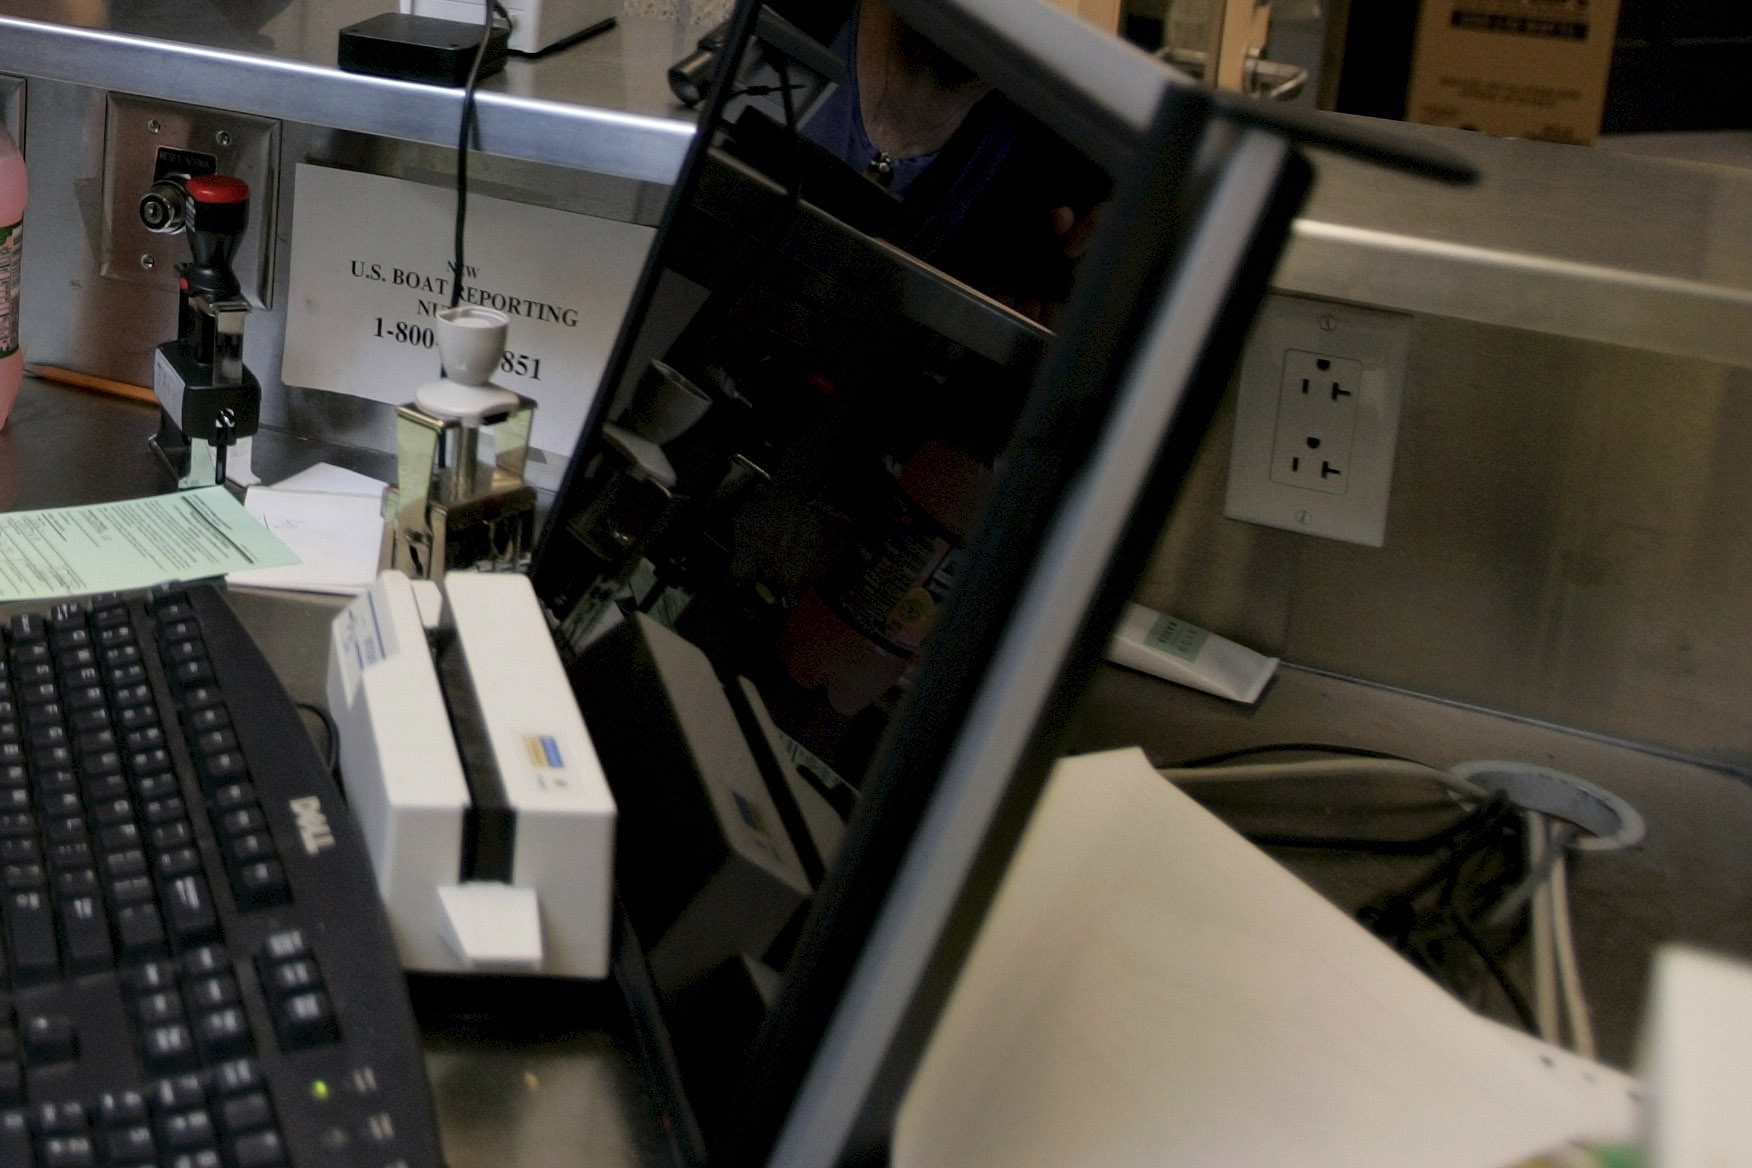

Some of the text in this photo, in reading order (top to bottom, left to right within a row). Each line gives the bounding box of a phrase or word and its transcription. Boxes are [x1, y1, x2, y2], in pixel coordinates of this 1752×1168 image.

[447, 259, 480, 279] NW
[350, 260, 386, 282] U.S.
[392, 267, 448, 295] BOAT
[459, 284, 579, 328] REPORTING
